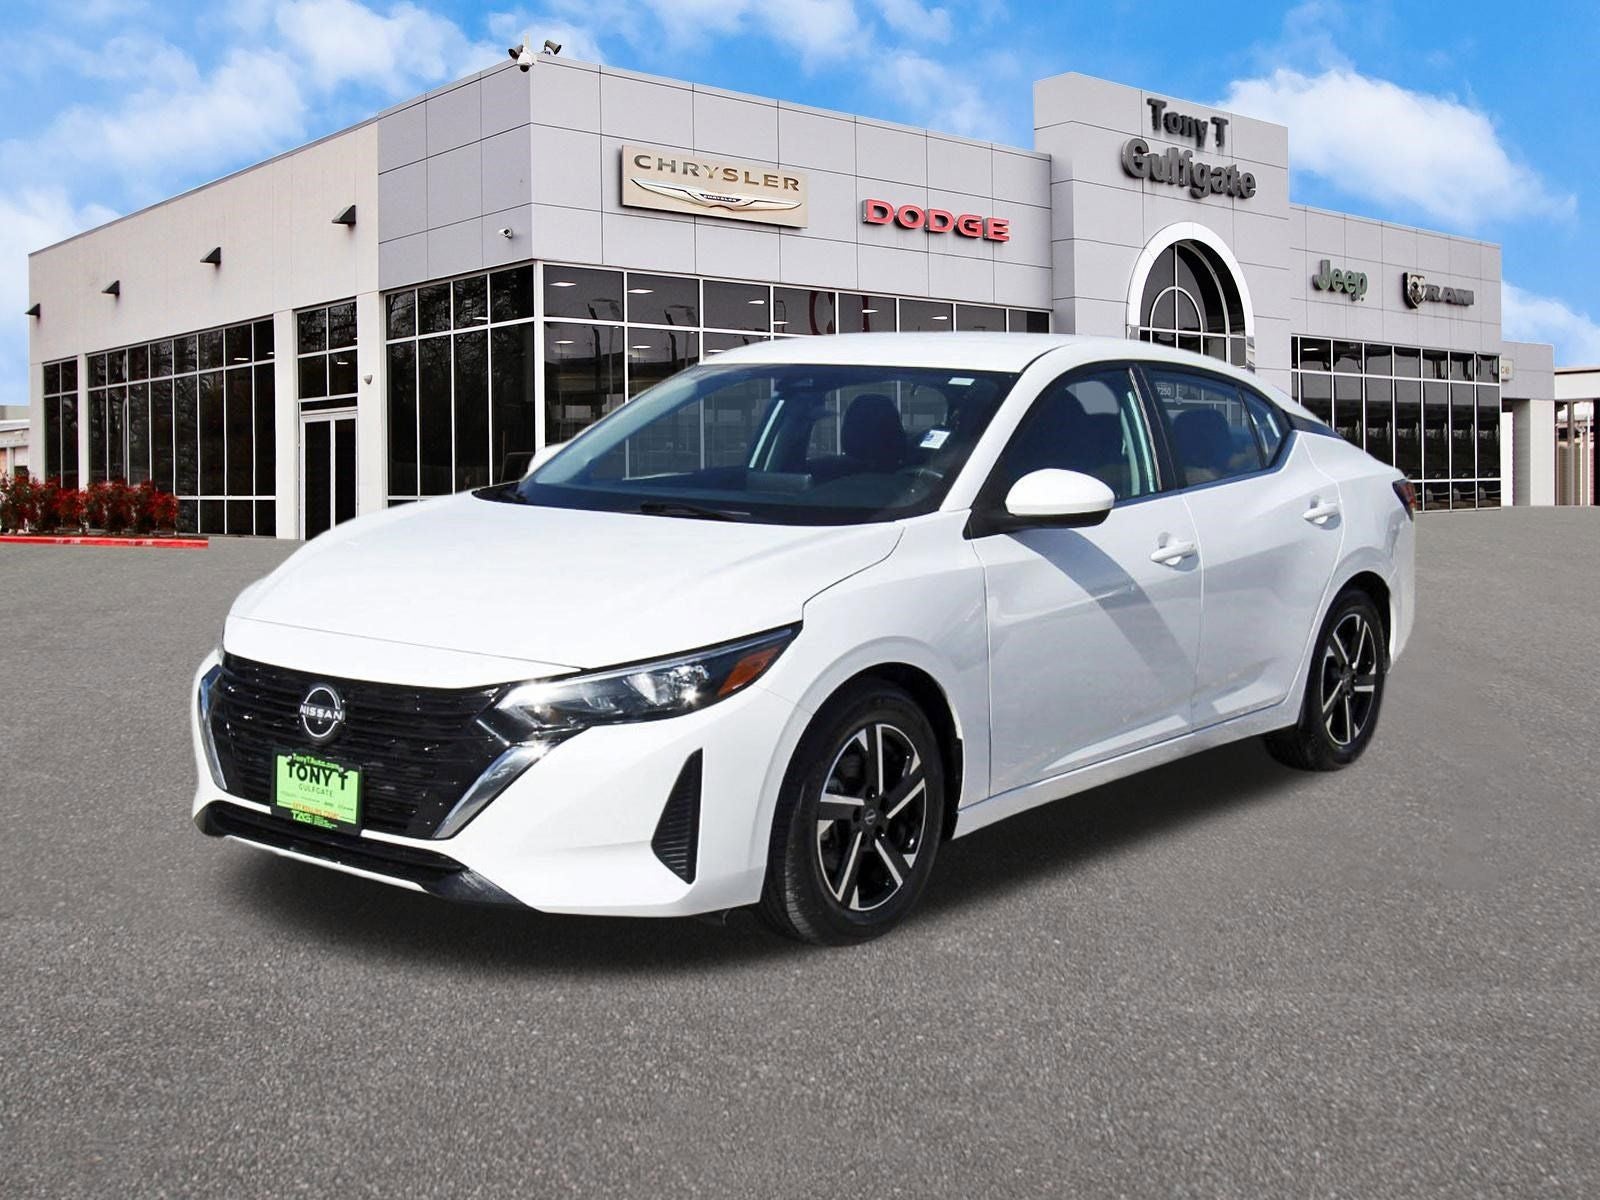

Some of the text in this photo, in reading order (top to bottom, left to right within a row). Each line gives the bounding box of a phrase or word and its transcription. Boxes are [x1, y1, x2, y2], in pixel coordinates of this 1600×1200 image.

[1147, 98, 1229, 147] Tony T
[633, 154, 800, 191] CHRYSLER
[1121, 138, 1257, 199] Gulfgate
[862, 198, 1010, 242] DODGE
[1312, 259, 1368, 302] Jeep
[1424, 283, 1474, 306] RAM
[300, 704, 343, 720] NISSAN
[286, 759, 333, 787] TONY
[338, 771, 349, 791] T
[298, 784, 334, 797] GULFGATE
